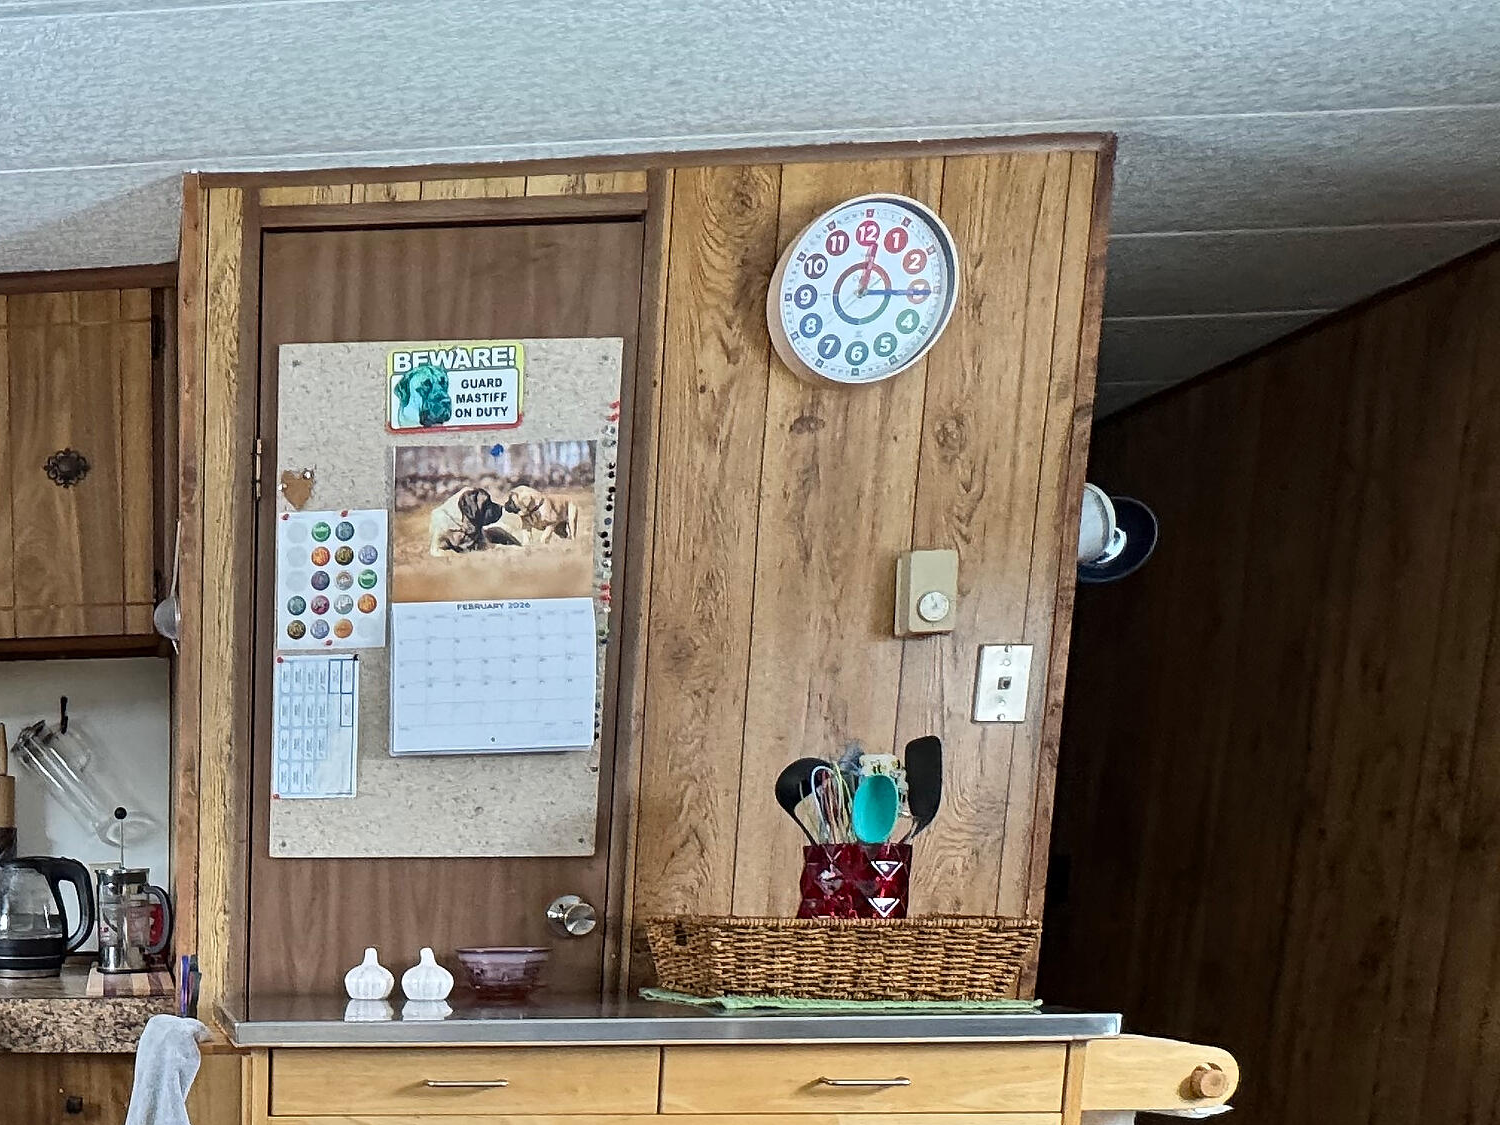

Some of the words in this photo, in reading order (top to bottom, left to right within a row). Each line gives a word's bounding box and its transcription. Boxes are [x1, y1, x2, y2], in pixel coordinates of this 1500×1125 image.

[859, 225, 877, 242] 12
[892, 233, 900, 249] 1
[831, 235, 845, 252] 11
[806, 258, 826, 275] 10
[908, 254, 921, 270] 2
[800, 289, 812, 305] 9
[805, 317, 817, 334] 8
[901, 313, 914, 329] 4
[825, 340, 836, 355] 7
[880, 336, 891, 353] 5
[393, 347, 516, 372] BEWARE!
[851, 346, 863, 362] 6
[461, 378, 503, 389] GUARD
[456, 392, 508, 404] MASTIFF
[455, 409, 472, 419] ON
[476, 406, 509, 418] DUTY
[456, 602, 504, 611] FEBRUARY
